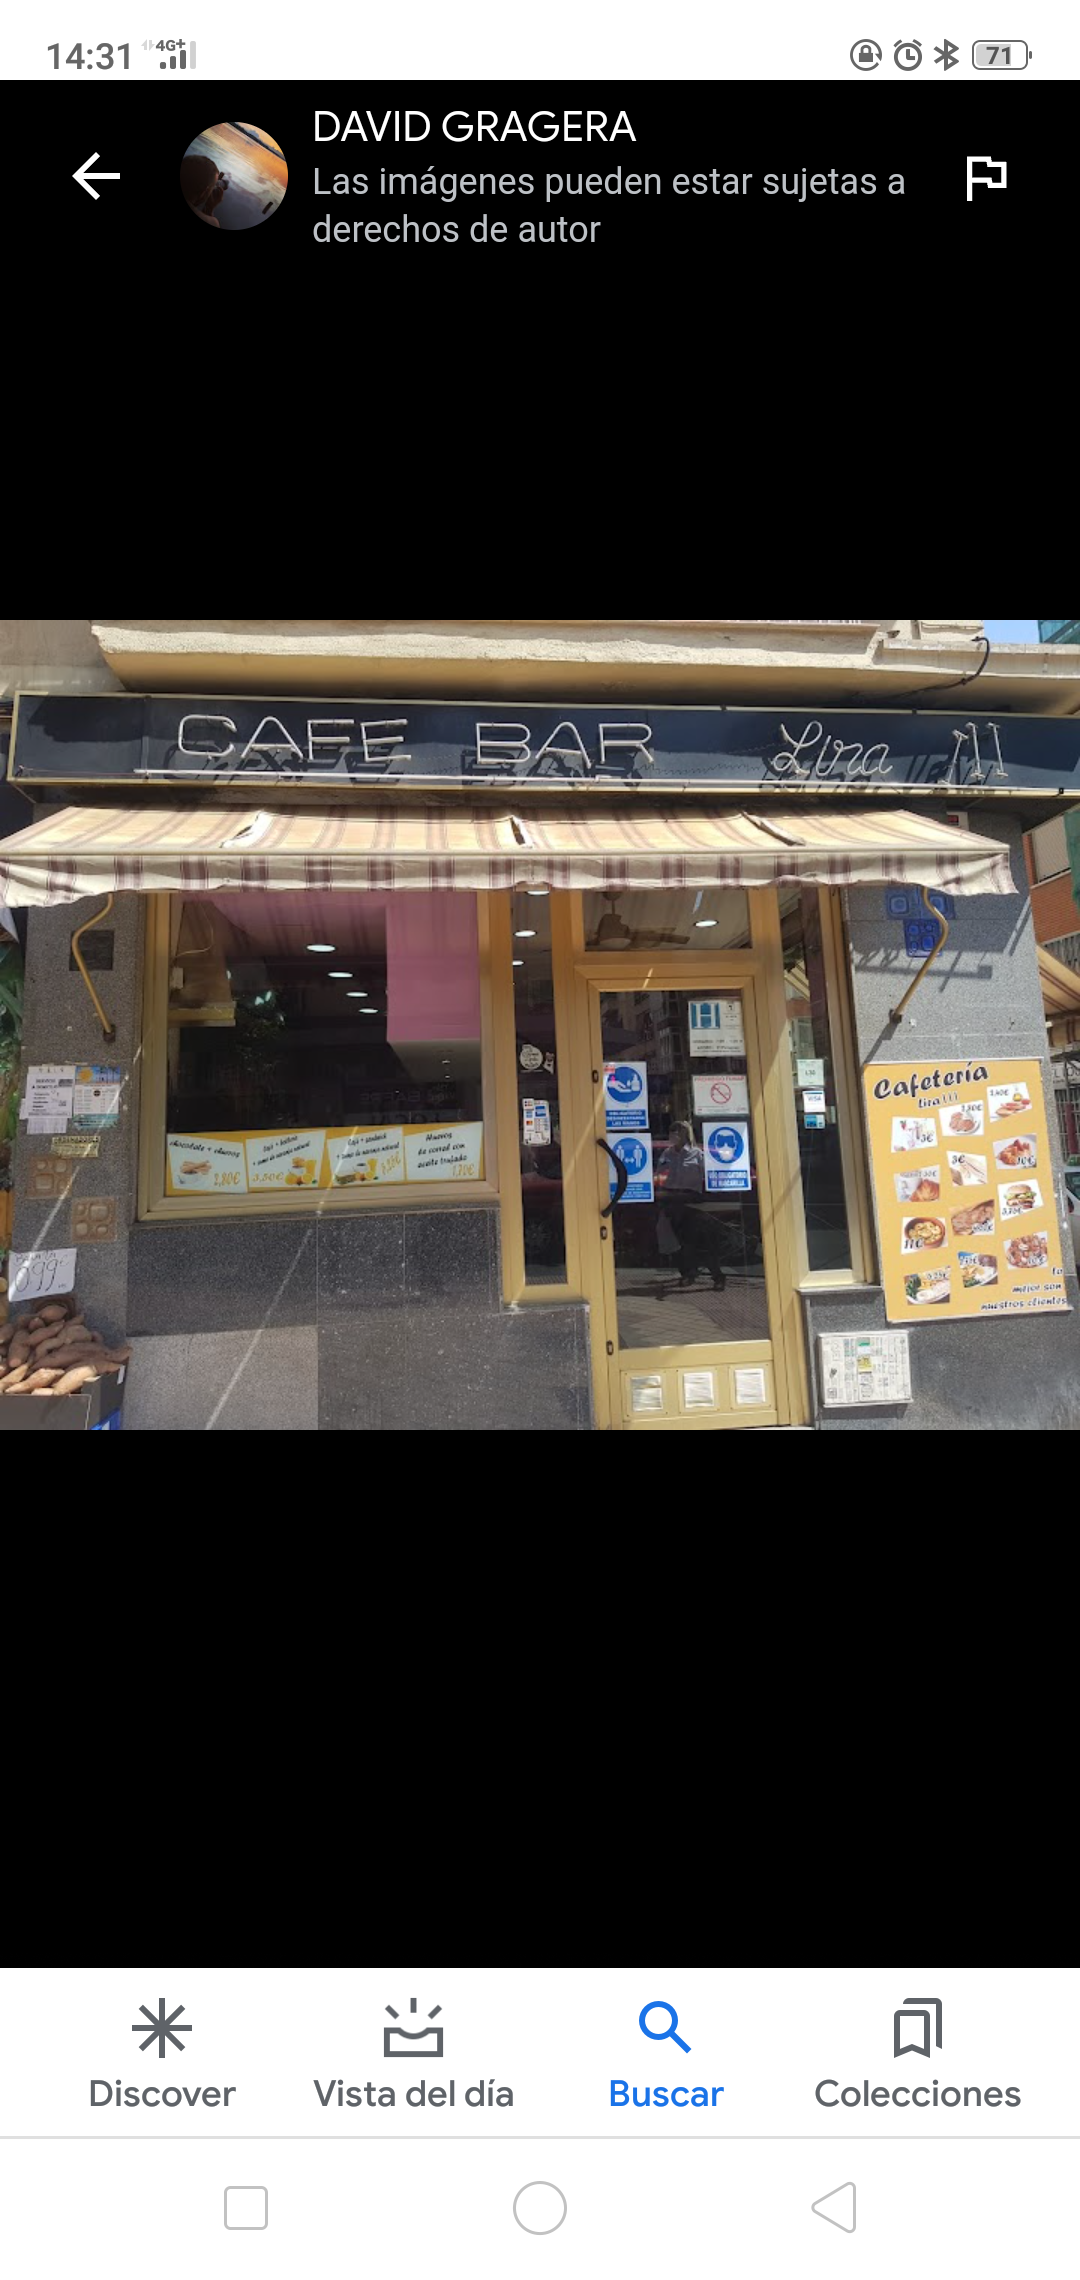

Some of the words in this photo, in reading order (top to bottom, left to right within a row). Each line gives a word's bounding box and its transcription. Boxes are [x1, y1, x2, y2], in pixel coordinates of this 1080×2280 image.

[177, 714, 412, 762] CAFE
[476, 721, 654, 768] BAR
[771, 720, 893, 777] Lira
[873, 1061, 989, 1099] Cafetería
[169, 1140, 205, 1152] chocolate
[981, 1300, 1024, 1310] nuestros
[1027, 1296, 1068, 1306] clientes
